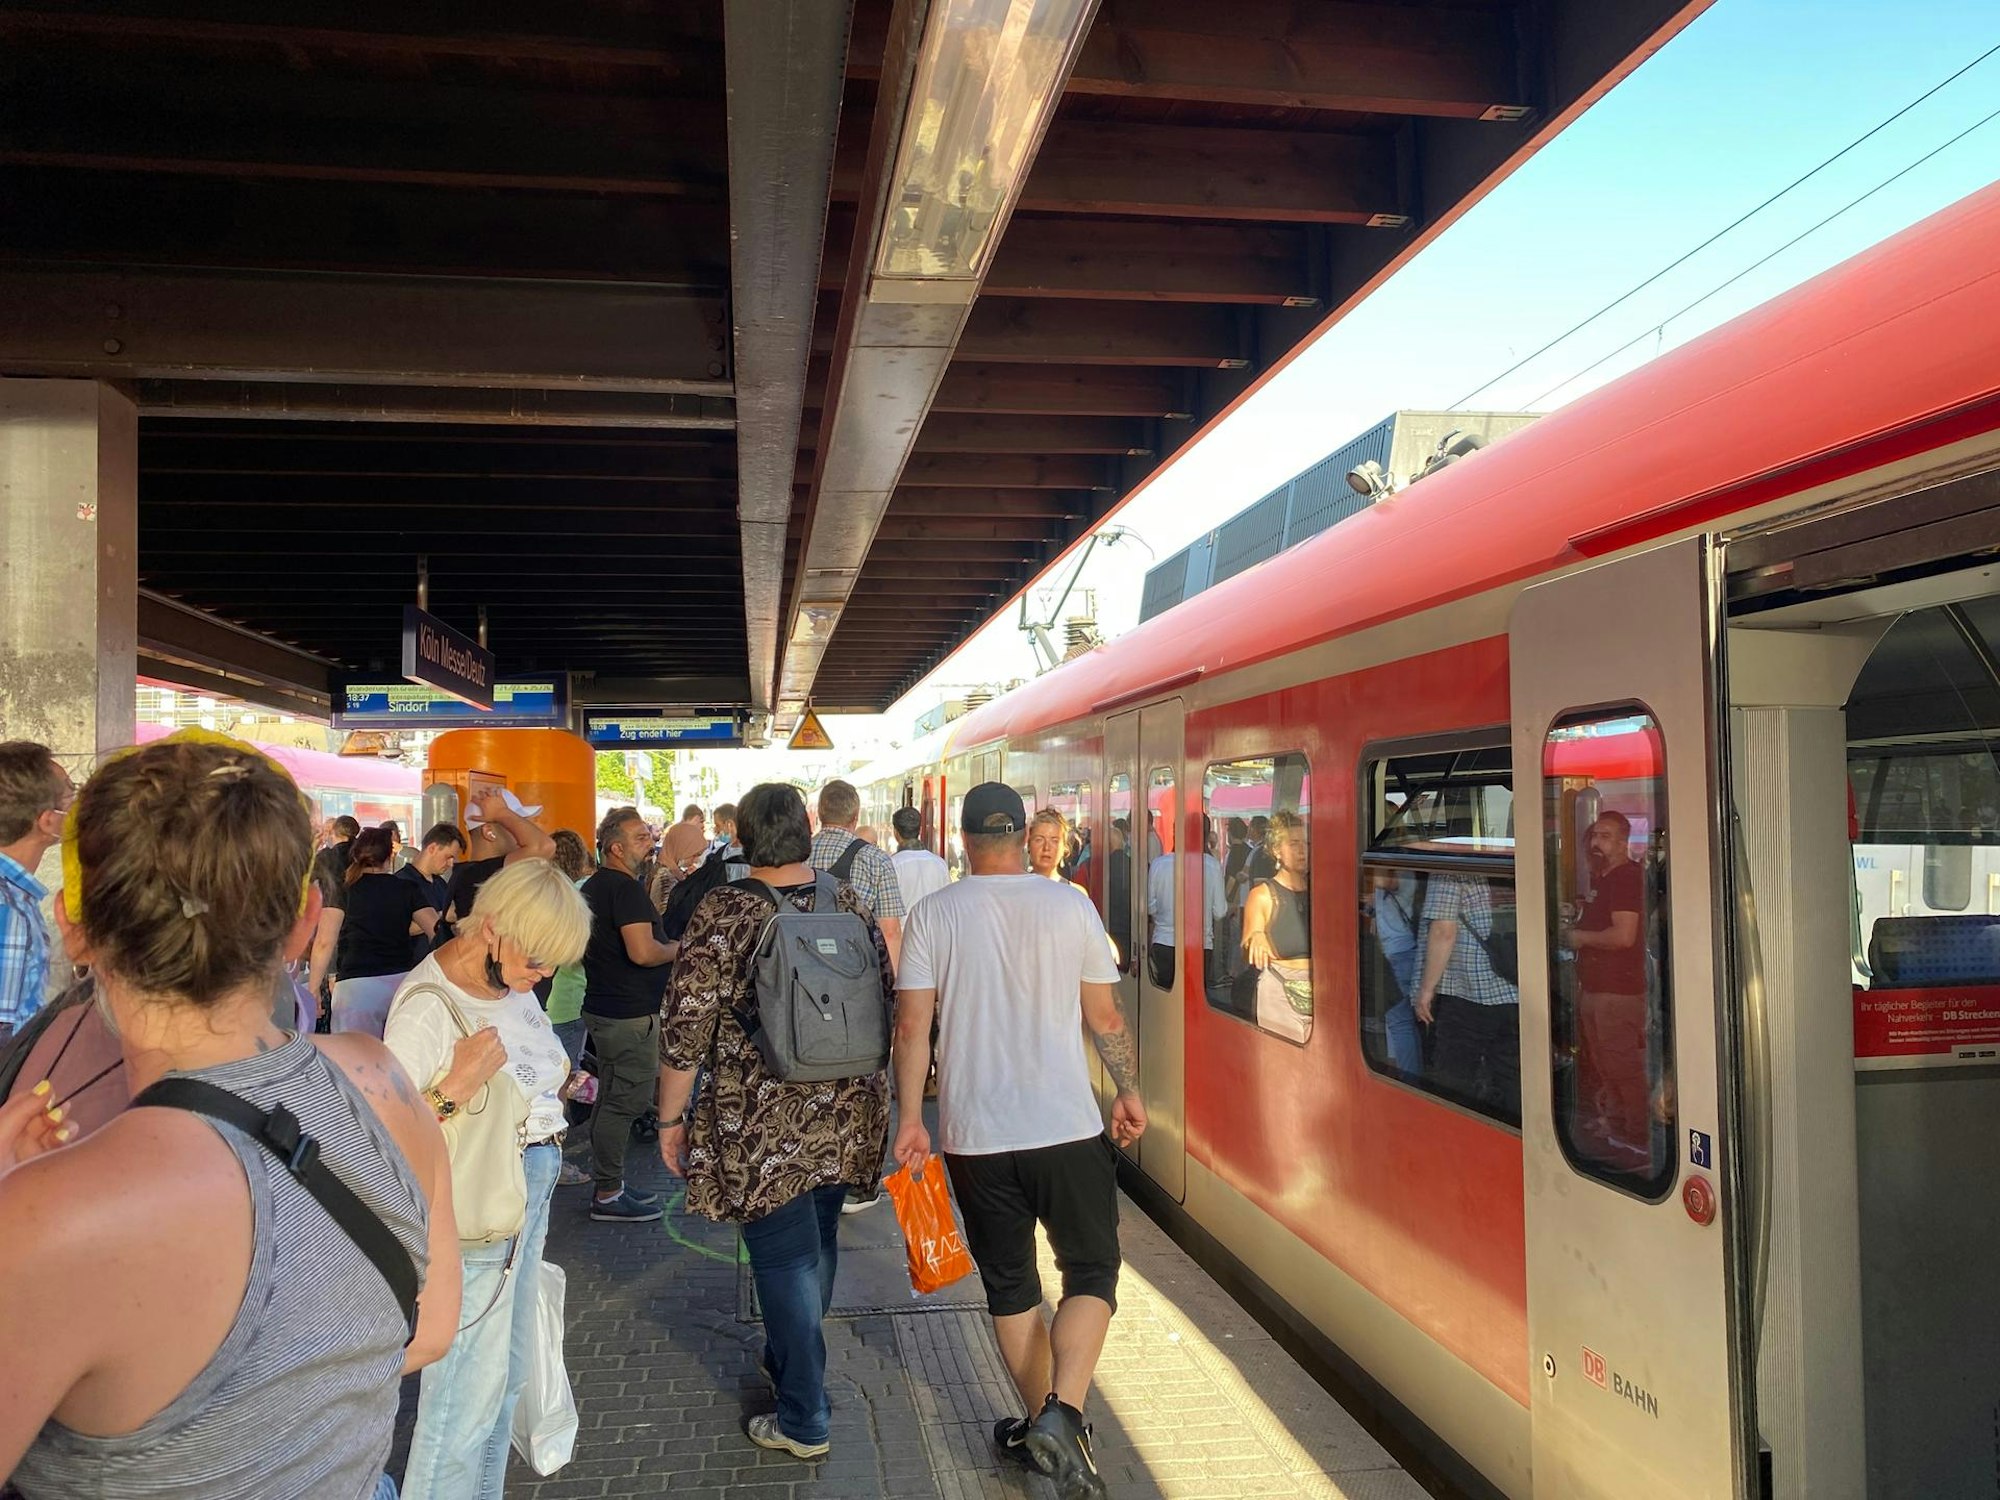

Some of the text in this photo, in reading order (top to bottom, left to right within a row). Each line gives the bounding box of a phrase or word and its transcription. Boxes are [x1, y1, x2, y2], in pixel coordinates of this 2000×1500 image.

[420, 622, 486, 688] Köln Messe/Deutz
[388, 701, 429, 713] Sindorf
[620, 730, 683, 740] Zug endet hier
[1861, 998, 1977, 1013] Ihr täglicher Begleiter für den
[1888, 1013, 1933, 1023] Nahverkehr
[1943, 1011, 1957, 1021] DB
[1583, 1350, 1659, 1420] DB BAHN
